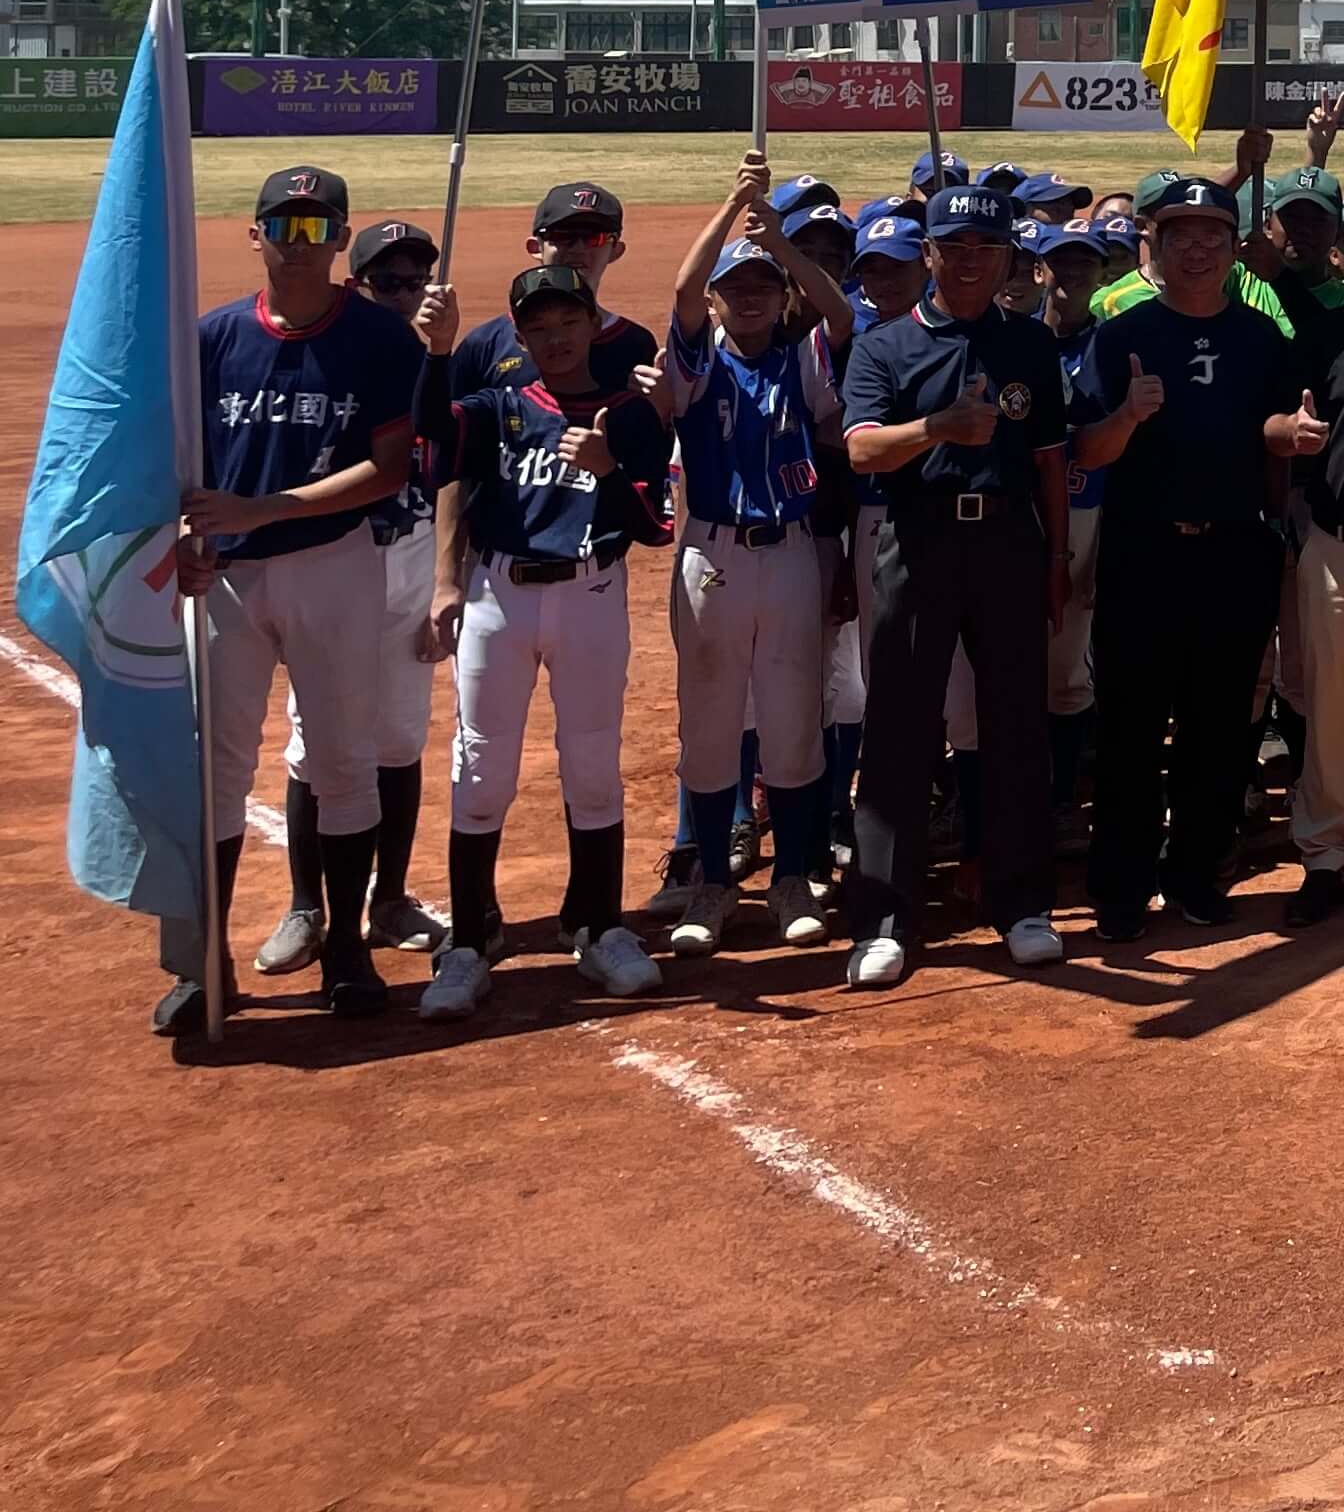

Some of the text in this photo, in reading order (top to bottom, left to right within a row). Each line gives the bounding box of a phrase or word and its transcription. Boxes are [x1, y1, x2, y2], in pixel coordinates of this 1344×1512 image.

[0, 67, 118, 98] 上建設
[272, 68, 420, 95] 浯江大飯店
[565, 63, 701, 94] 喬安牧場
[1065, 76, 1138, 111] 823
[564, 96, 701, 117] JOAN RANCH
[837, 78, 955, 111] 聖祖食品
[218, 390, 360, 430] 敦化國中
